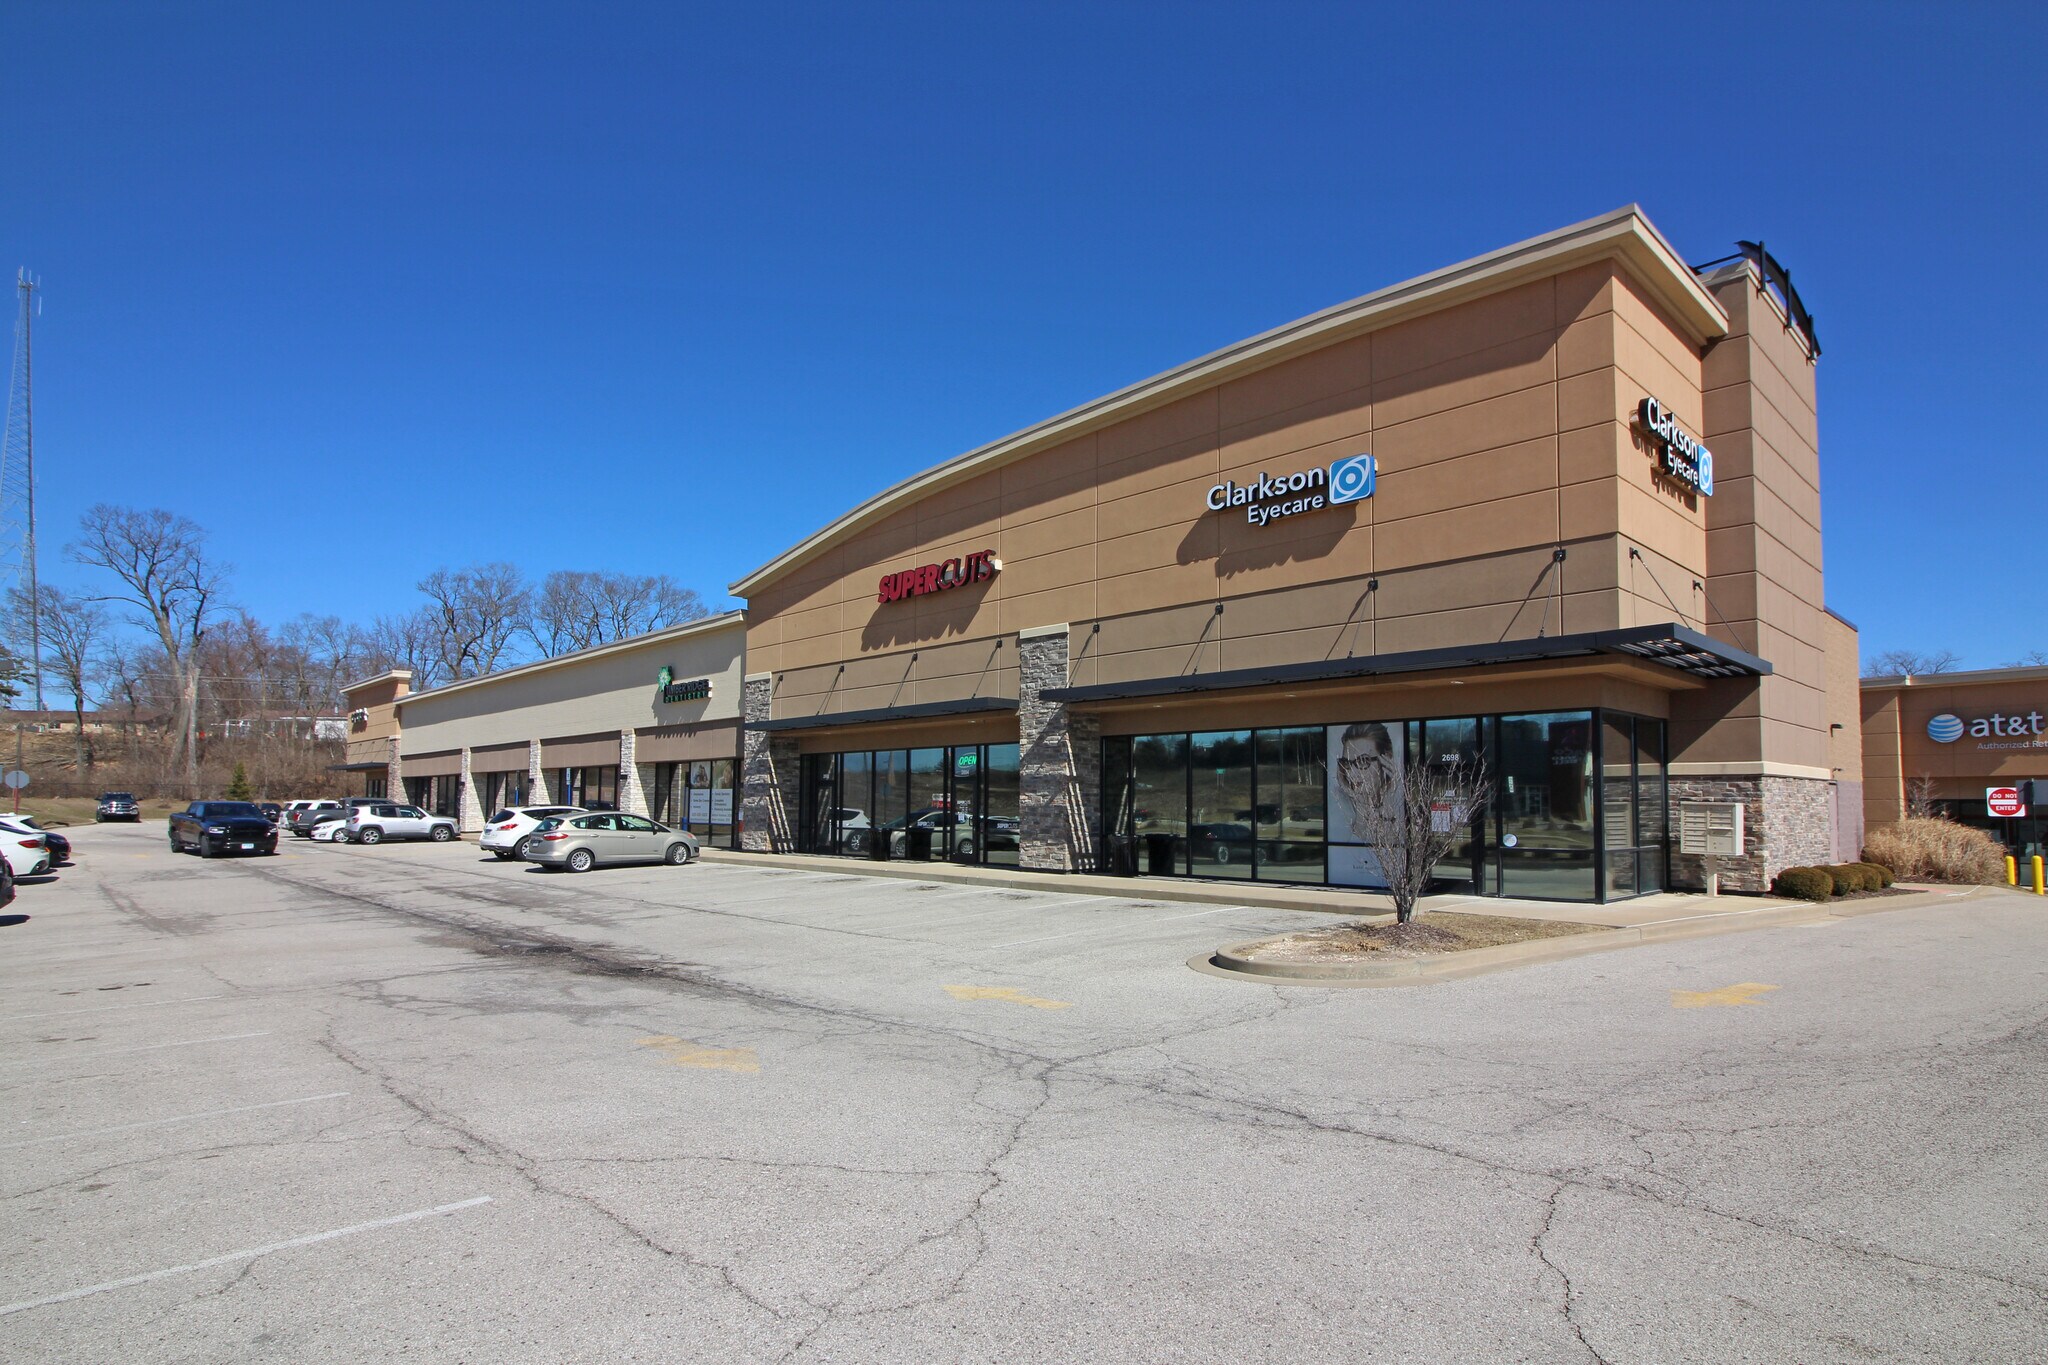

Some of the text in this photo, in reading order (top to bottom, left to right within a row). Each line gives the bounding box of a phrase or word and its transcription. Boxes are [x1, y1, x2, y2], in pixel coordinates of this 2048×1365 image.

[1647, 396, 1698, 462] Clarkson
[1667, 444, 1699, 485] Eyecare
[1206, 467, 1326, 511] Clarkson
[1247, 494, 1325, 526] Eyecare
[878, 549, 996, 603] SUPERCUTS
[1970, 711, 2043, 738] at&t
[959, 755, 977, 765] OPEN
[1441, 753, 1460, 762] 2698
[1977, 740, 2029, 750] Authorized
